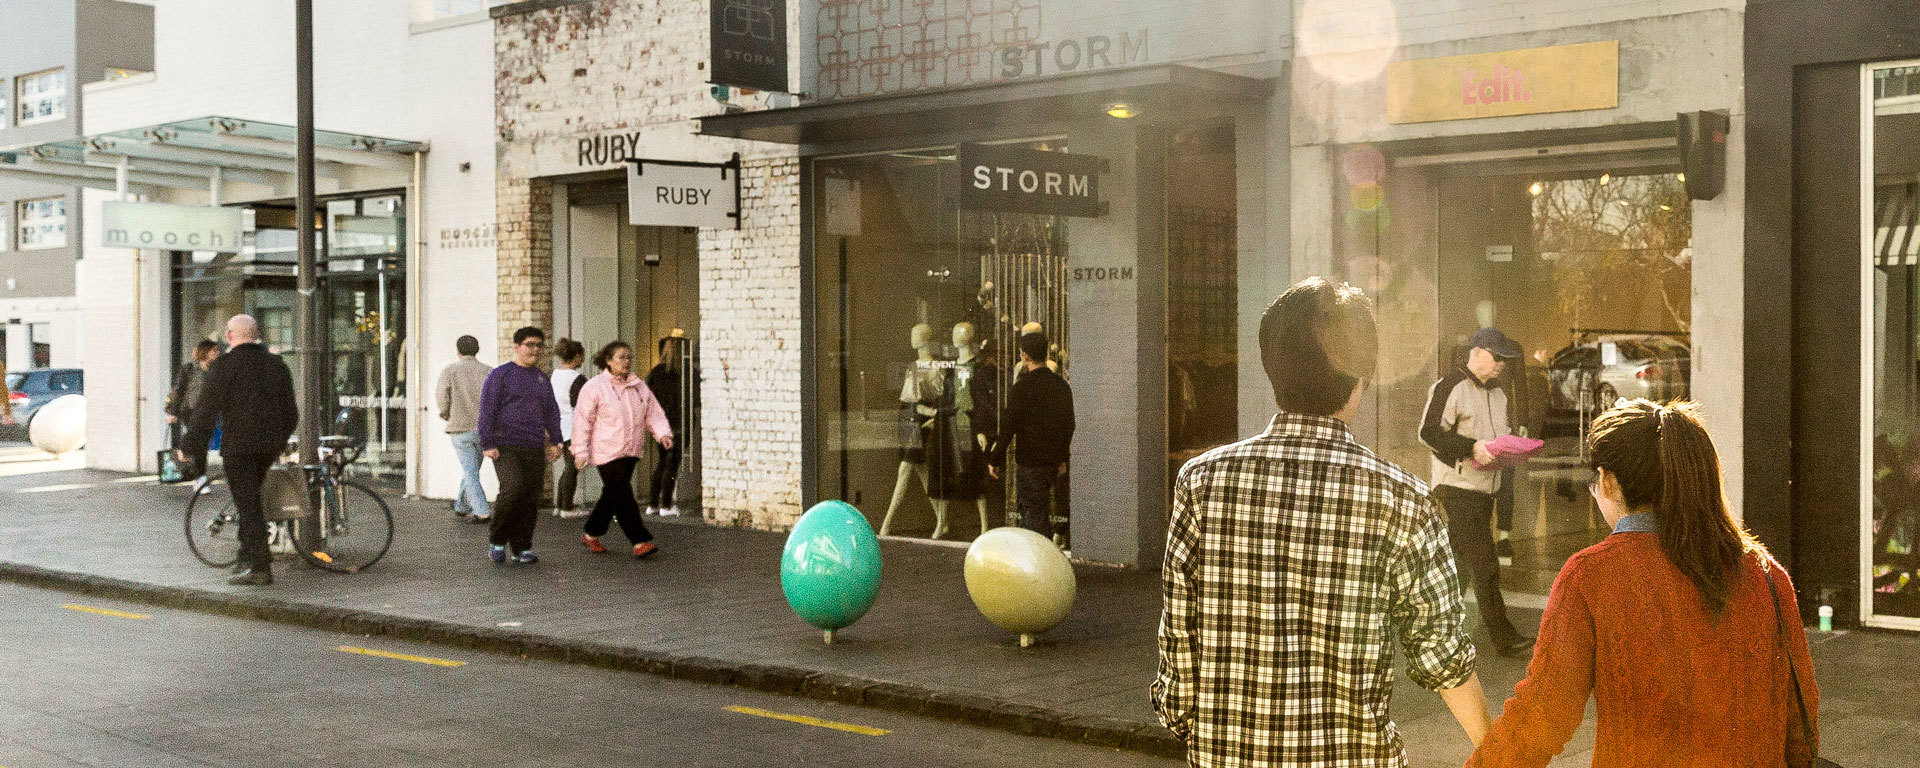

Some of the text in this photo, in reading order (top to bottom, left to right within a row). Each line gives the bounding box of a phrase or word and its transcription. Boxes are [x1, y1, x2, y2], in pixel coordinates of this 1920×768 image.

[723, 49, 776, 66] STORM
[1000, 29, 1149, 77] STORM
[1462, 63, 1532, 105] Edit.
[577, 131, 641, 167] RUBY
[973, 165, 1089, 197] STORM
[655, 186, 712, 206] RUBY
[107, 229, 239, 248] moochi
[1073, 266, 1133, 281] STORM
